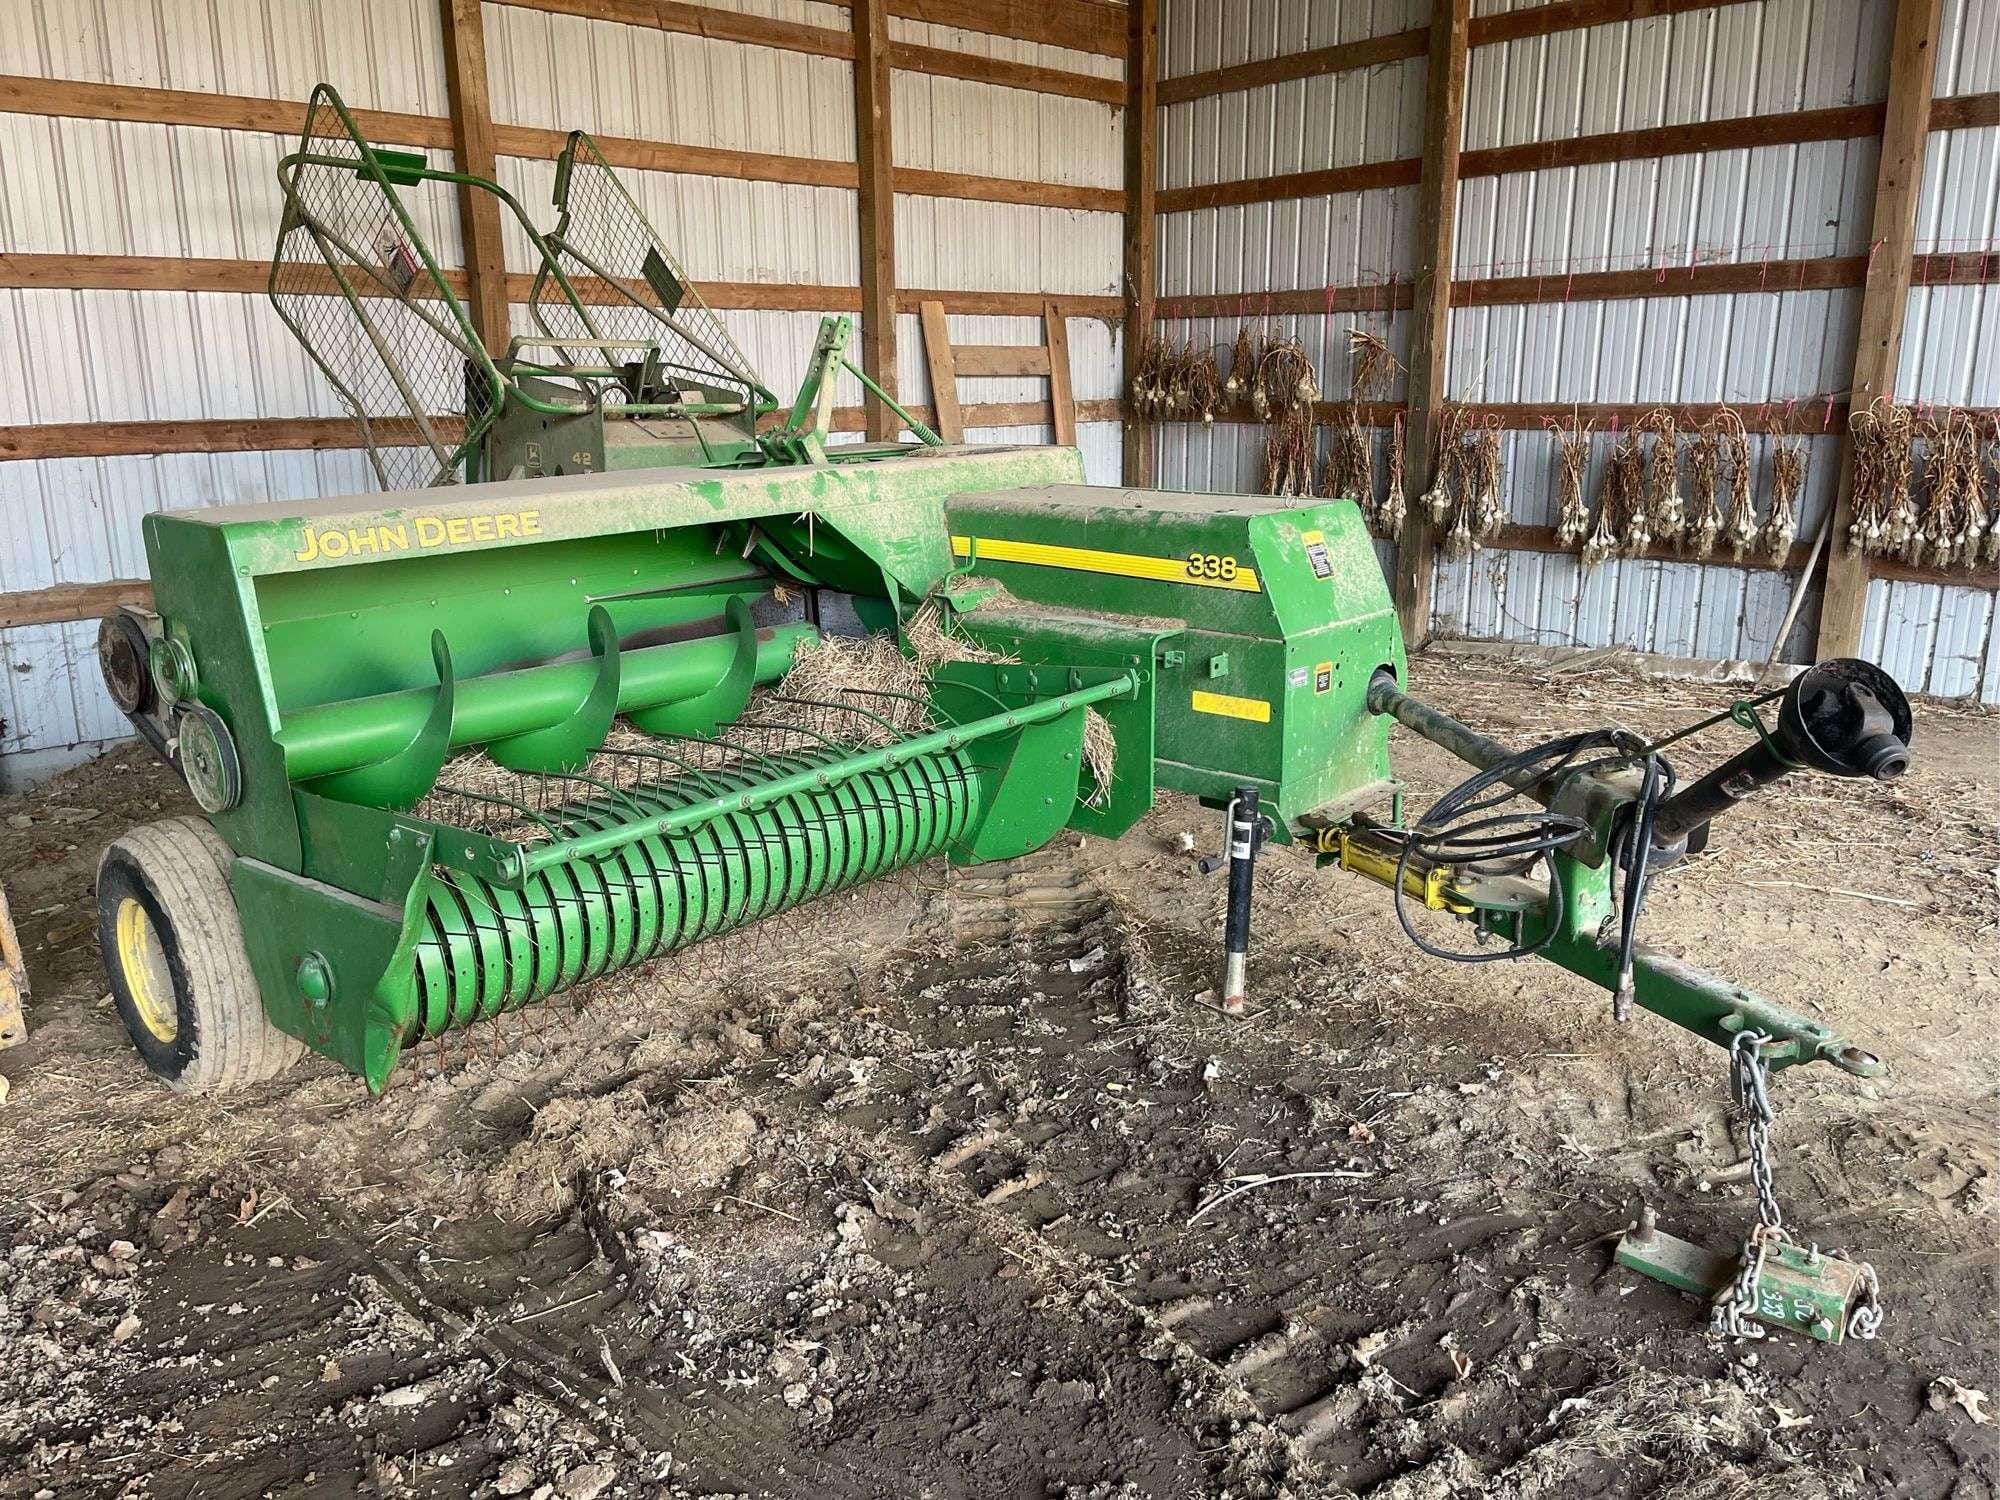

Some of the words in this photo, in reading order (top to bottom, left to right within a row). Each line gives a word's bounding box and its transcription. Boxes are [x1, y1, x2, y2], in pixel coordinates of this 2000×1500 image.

[572, 451, 592, 466] 42
[295, 526, 409, 563] JOHN
[414, 511, 544, 548] DEERE
[1187, 552, 1237, 580] 338
